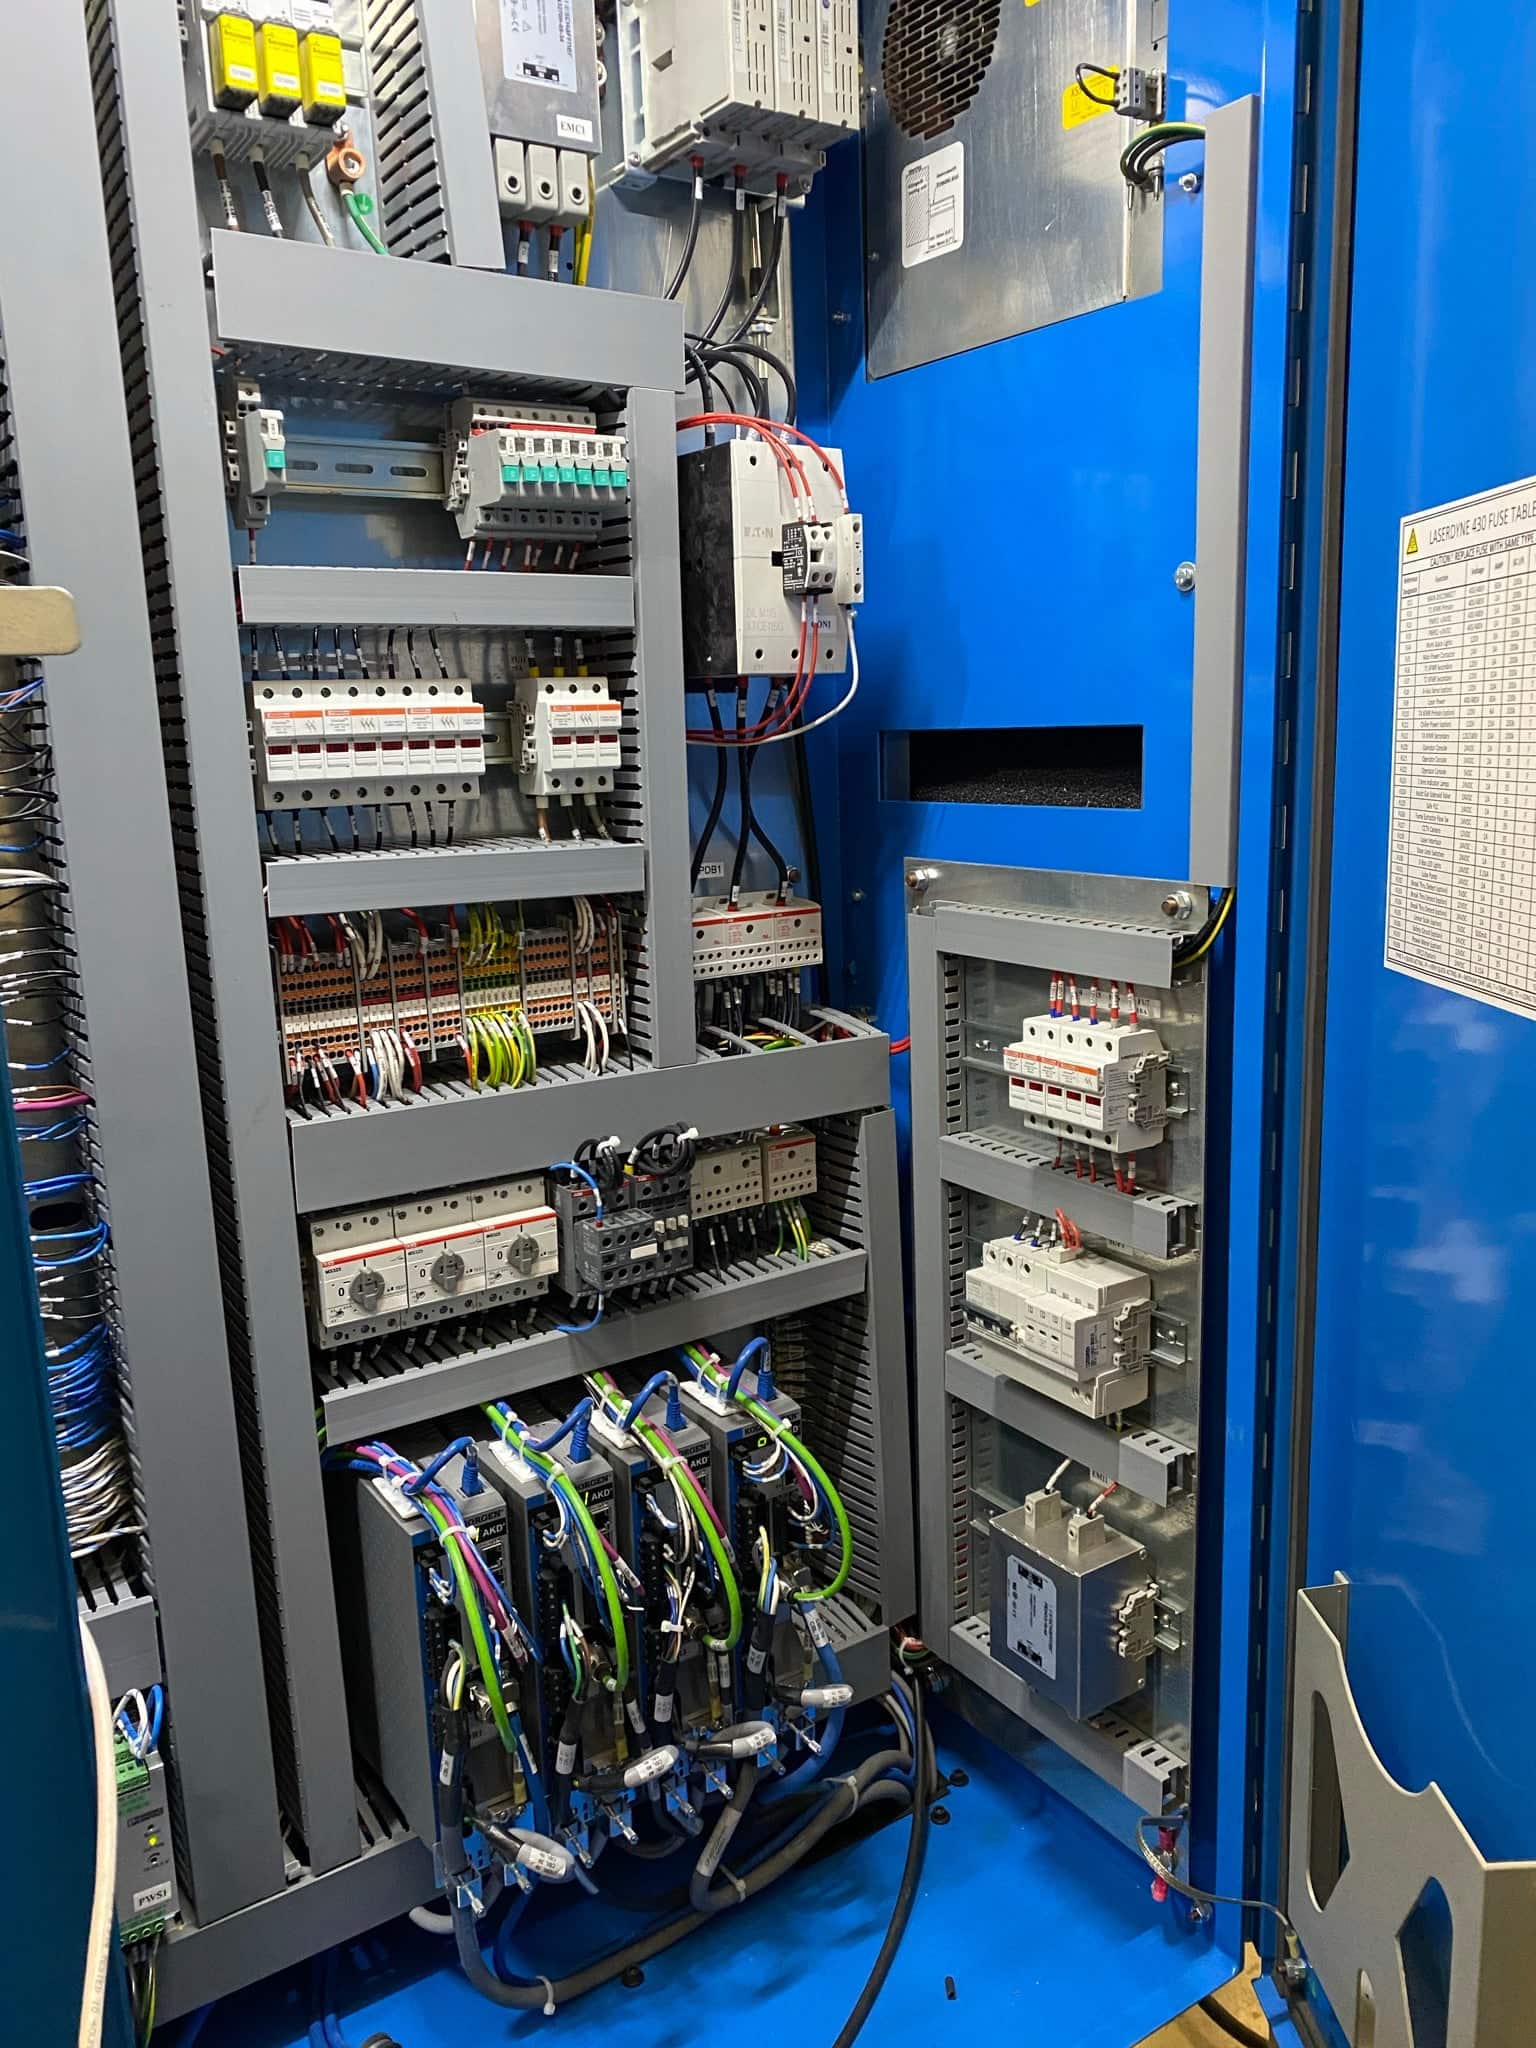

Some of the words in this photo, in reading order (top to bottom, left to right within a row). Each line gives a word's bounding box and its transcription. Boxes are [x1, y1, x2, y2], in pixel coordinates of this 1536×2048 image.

[1430, 519, 1470, 545] LASERDYNE
[1472, 515, 1486, 531] 430
[1488, 508, 1509, 530] FUSE
[699, 864, 721, 875] PDB1
[592, 1488, 610, 1501] AKD
[482, 1523, 504, 1537] AKD
